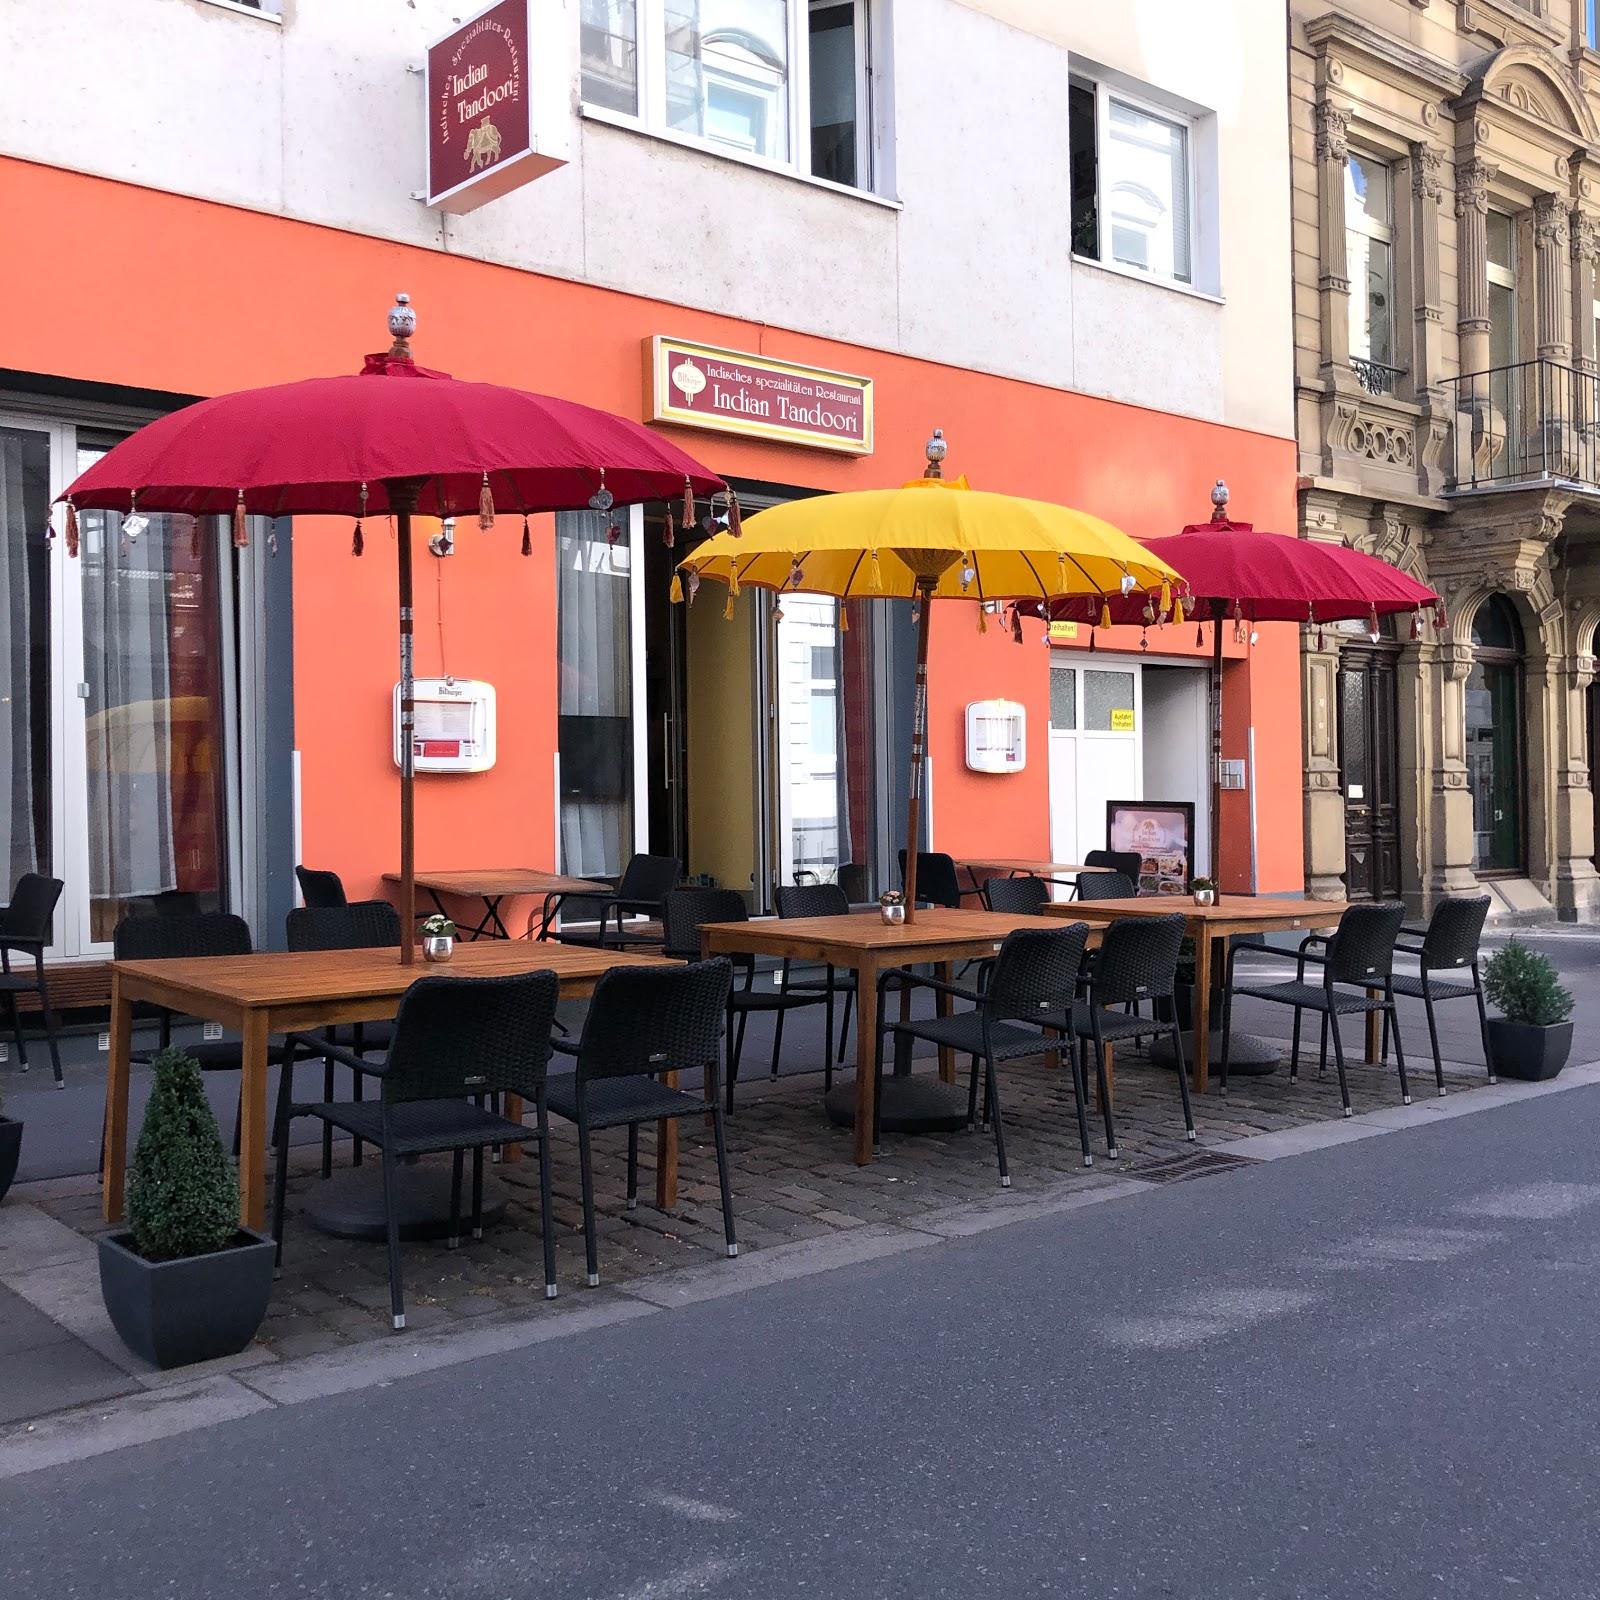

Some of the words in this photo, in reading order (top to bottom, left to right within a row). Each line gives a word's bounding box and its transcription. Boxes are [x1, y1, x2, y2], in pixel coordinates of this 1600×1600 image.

[452, 63, 488, 97] Indian
[457, 74, 514, 124] Tandoori
[706, 364, 753, 385] Indisches
[815, 385, 862, 406] Restaurant
[712, 384, 770, 417] Indian
[776, 395, 858, 433] Tandoori
